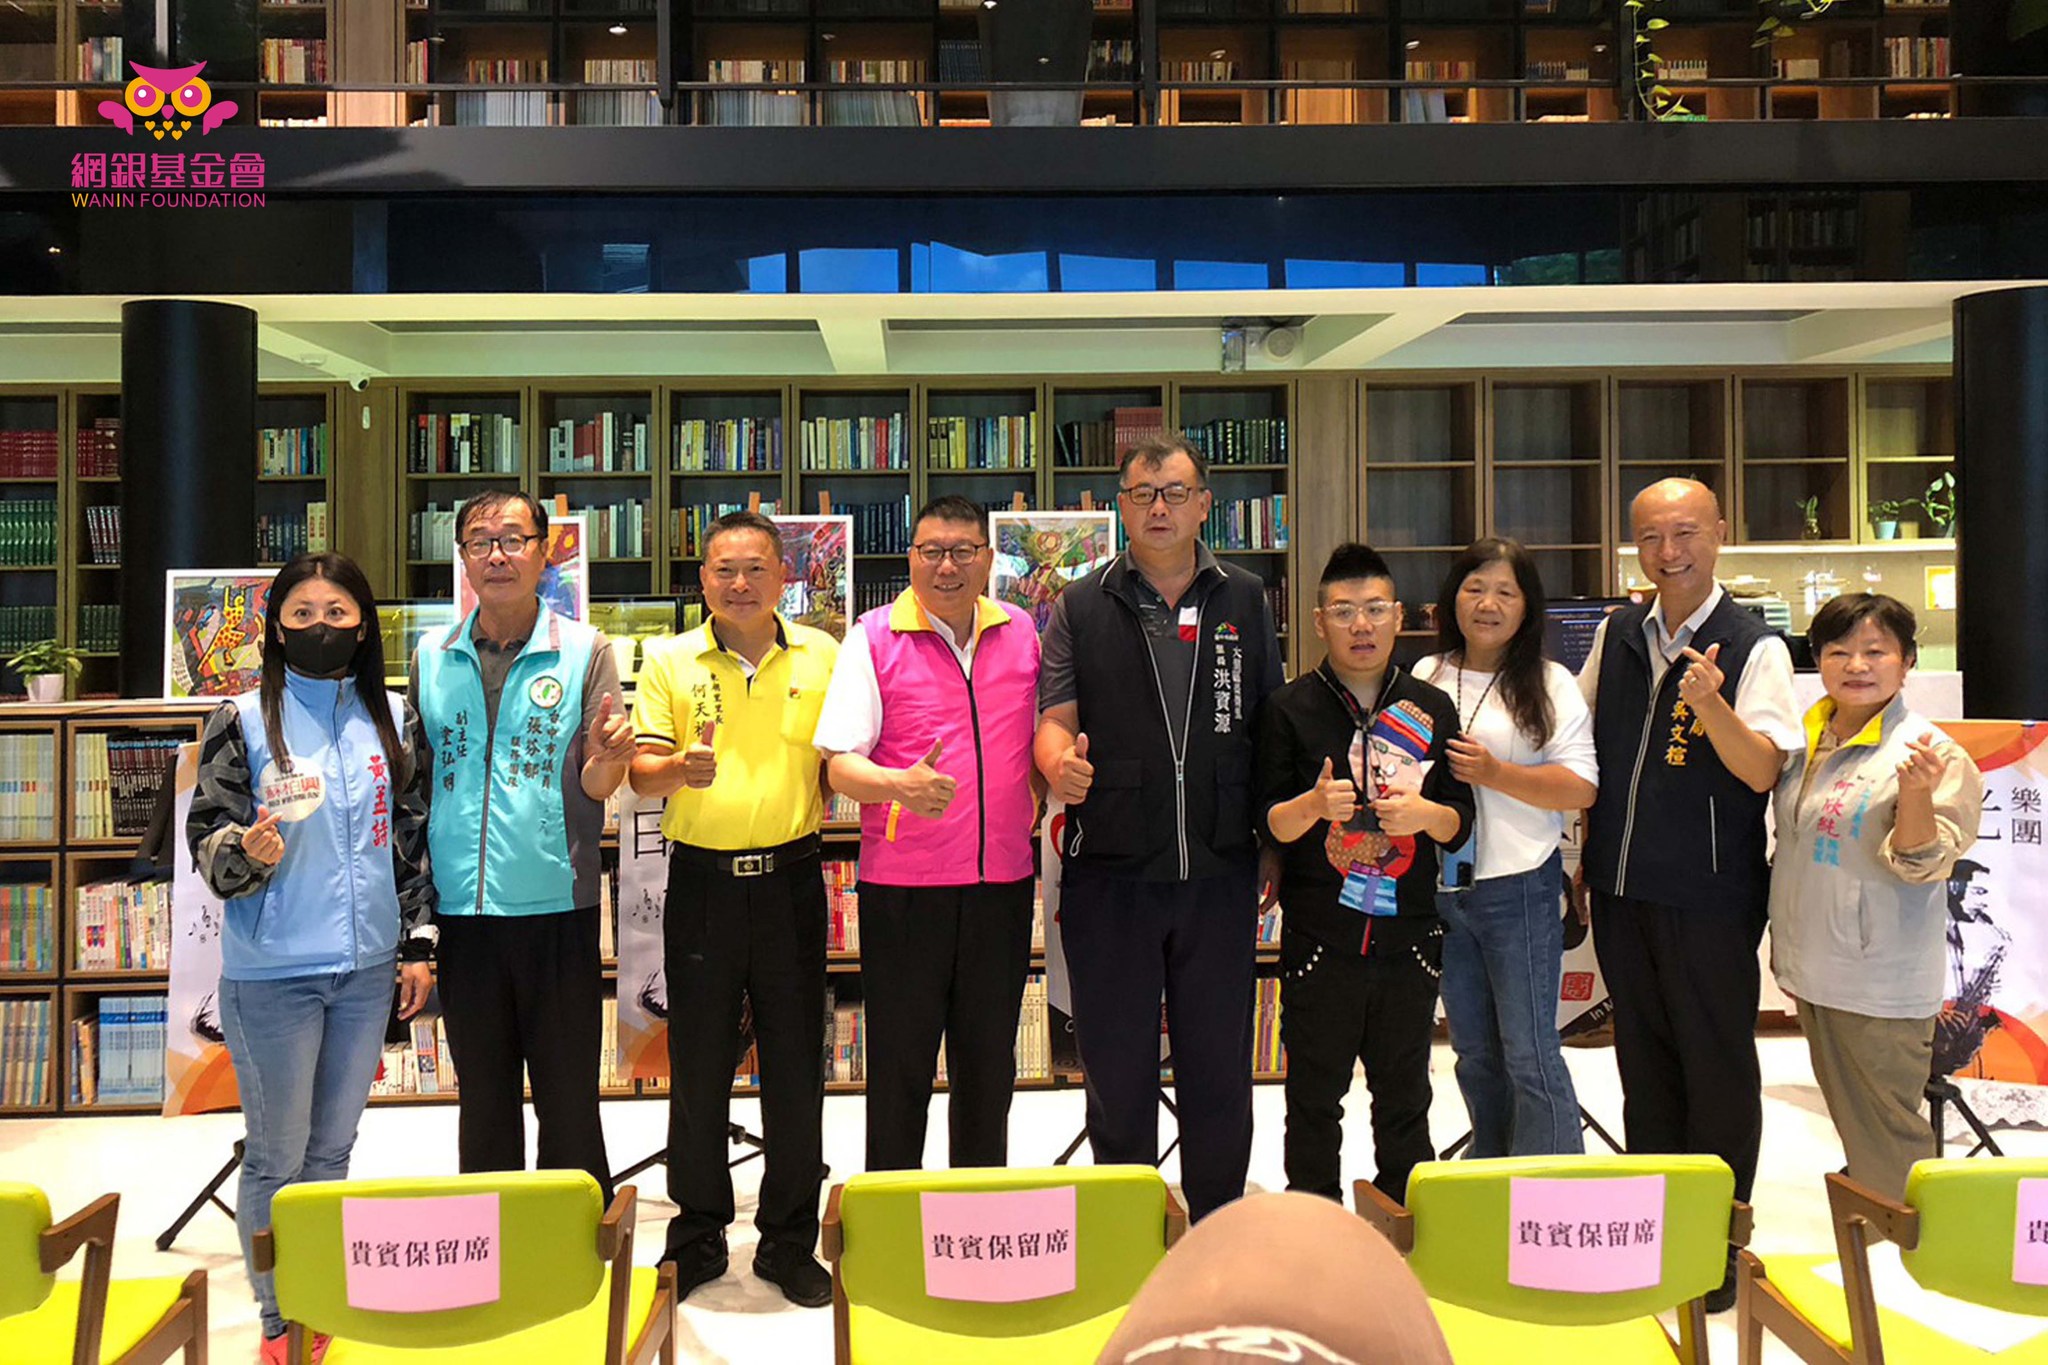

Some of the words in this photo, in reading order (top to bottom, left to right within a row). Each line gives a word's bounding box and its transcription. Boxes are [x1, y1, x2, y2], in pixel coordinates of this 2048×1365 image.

[2012, 786, 2041, 845] 樂團
[931, 1229, 1070, 1260] 貴賓保留席
[1517, 1218, 1656, 1249] 貴賓保留席
[351, 1236, 490, 1267] 貴賓保留席
